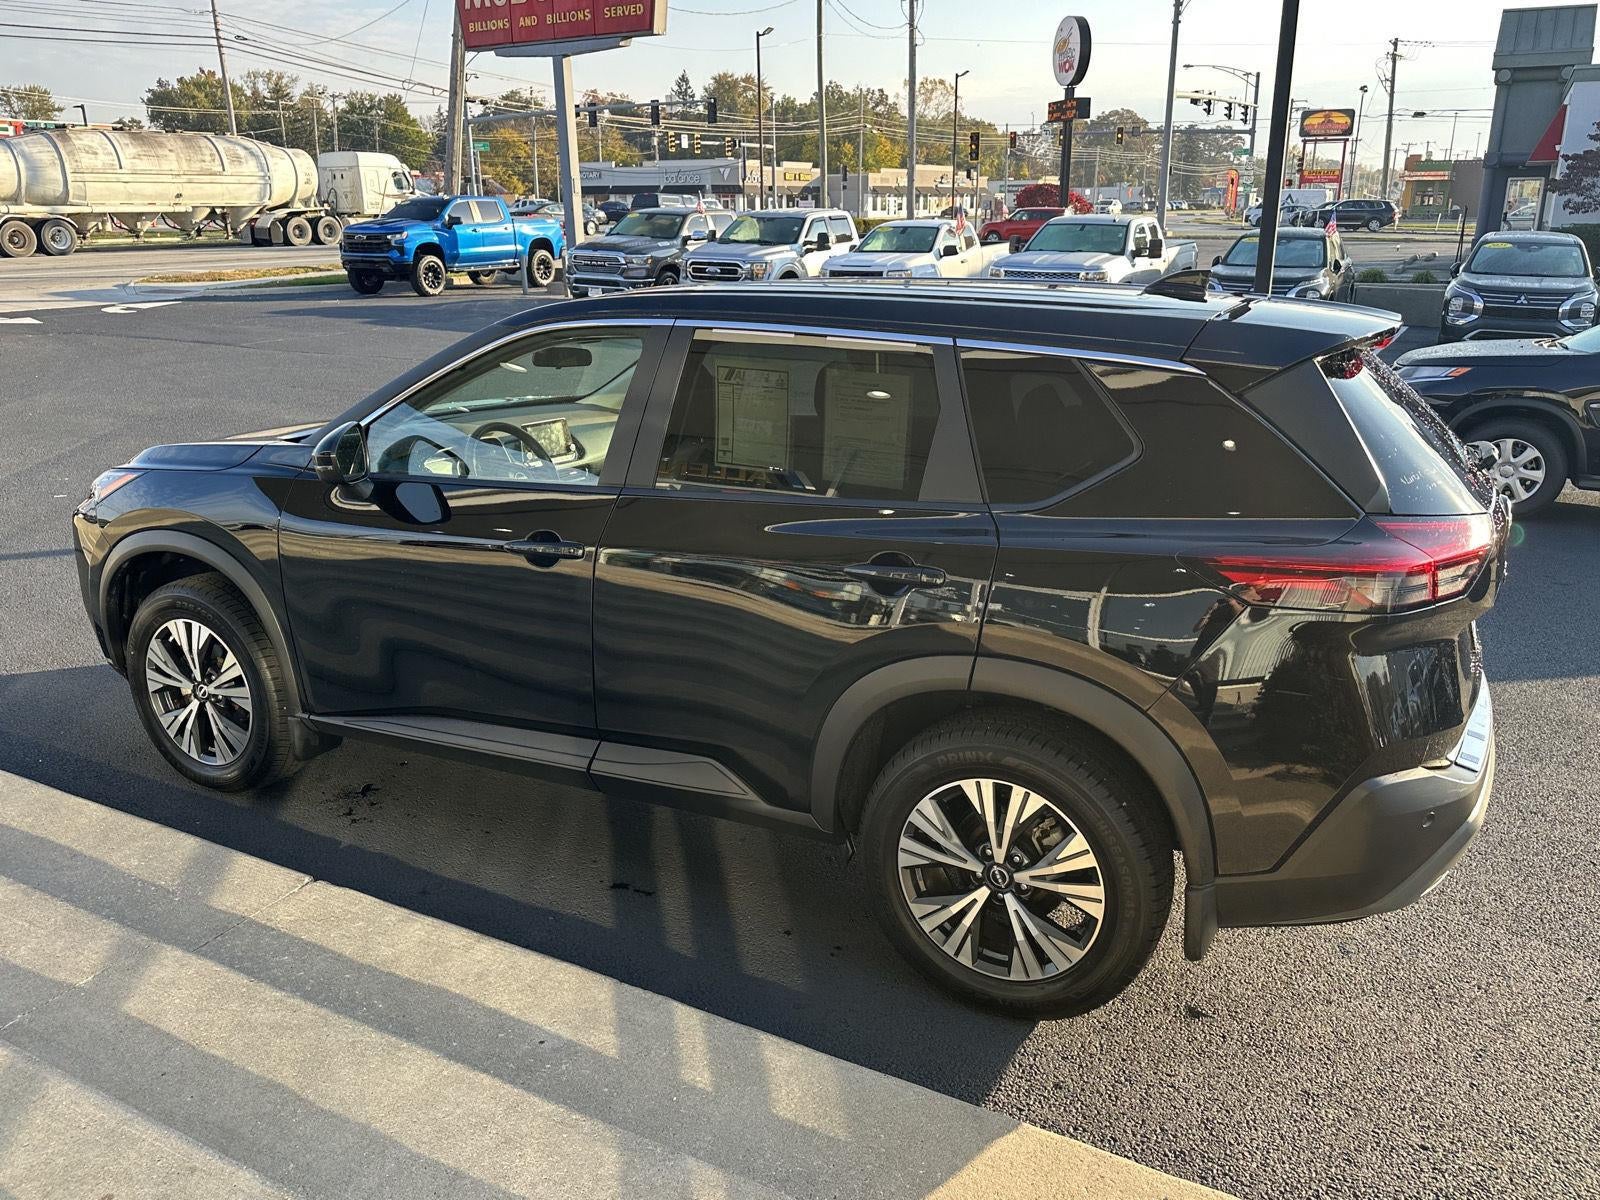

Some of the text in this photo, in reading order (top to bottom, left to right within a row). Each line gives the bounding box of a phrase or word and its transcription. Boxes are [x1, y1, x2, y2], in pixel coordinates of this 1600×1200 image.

[468, 4, 644, 33] BILLIONS AND BILLIONS SERVED
[1058, 59, 1075, 73] WOK
[579, 171, 601, 179] OTARY
